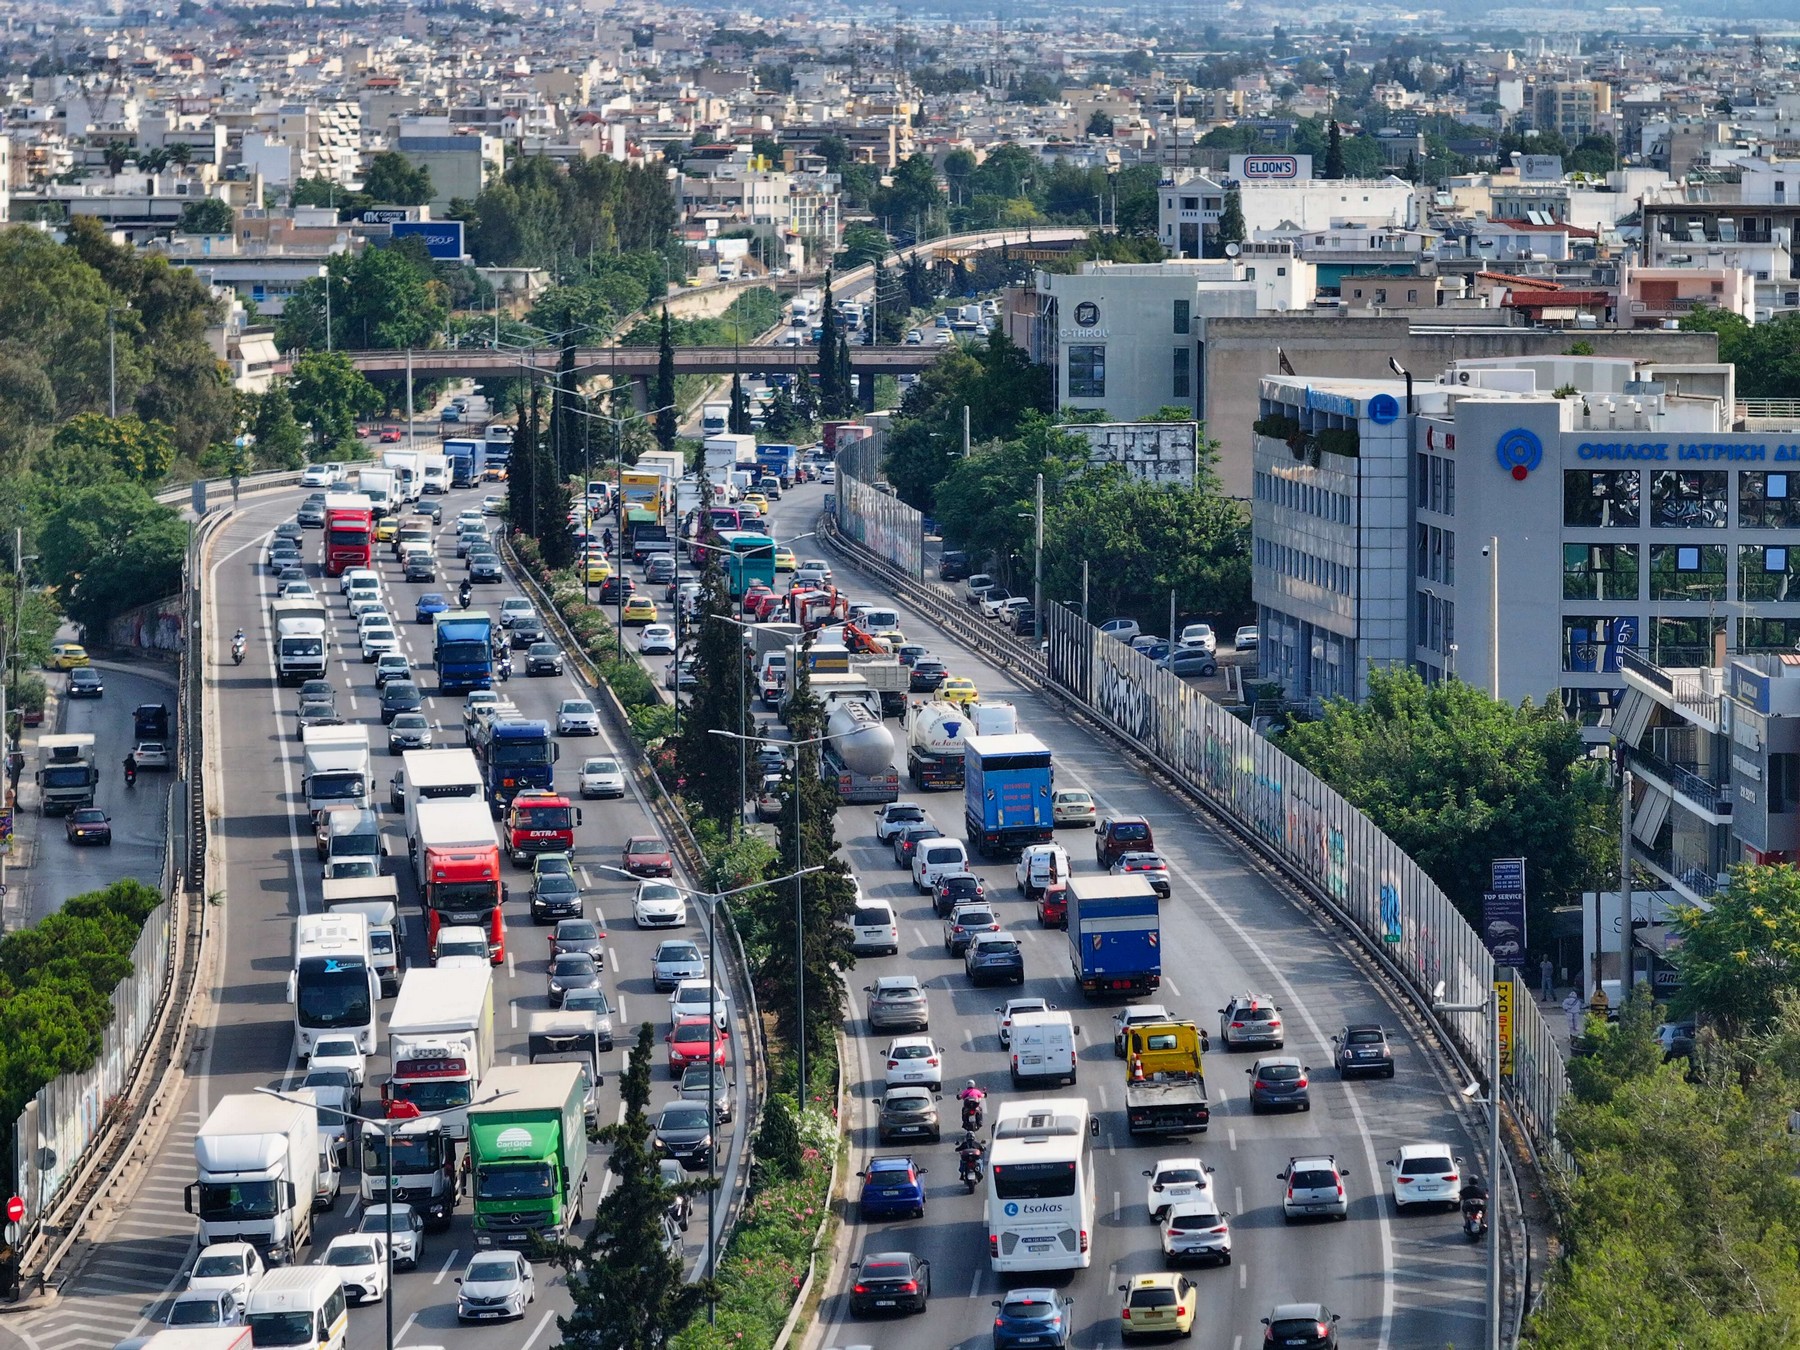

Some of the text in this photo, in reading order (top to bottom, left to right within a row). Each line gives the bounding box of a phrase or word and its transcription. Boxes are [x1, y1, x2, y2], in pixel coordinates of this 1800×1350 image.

[1249, 162, 1292, 173] ELDON'S
[363, 211, 380, 222] MK
[1577, 443, 1800, 461] ΟΜΙΛΟΣ ΙΑΤΡΙΚΗ ΔΙ
[416, 1061, 460, 1071] rota
[1023, 1202, 1063, 1213] tsokas
